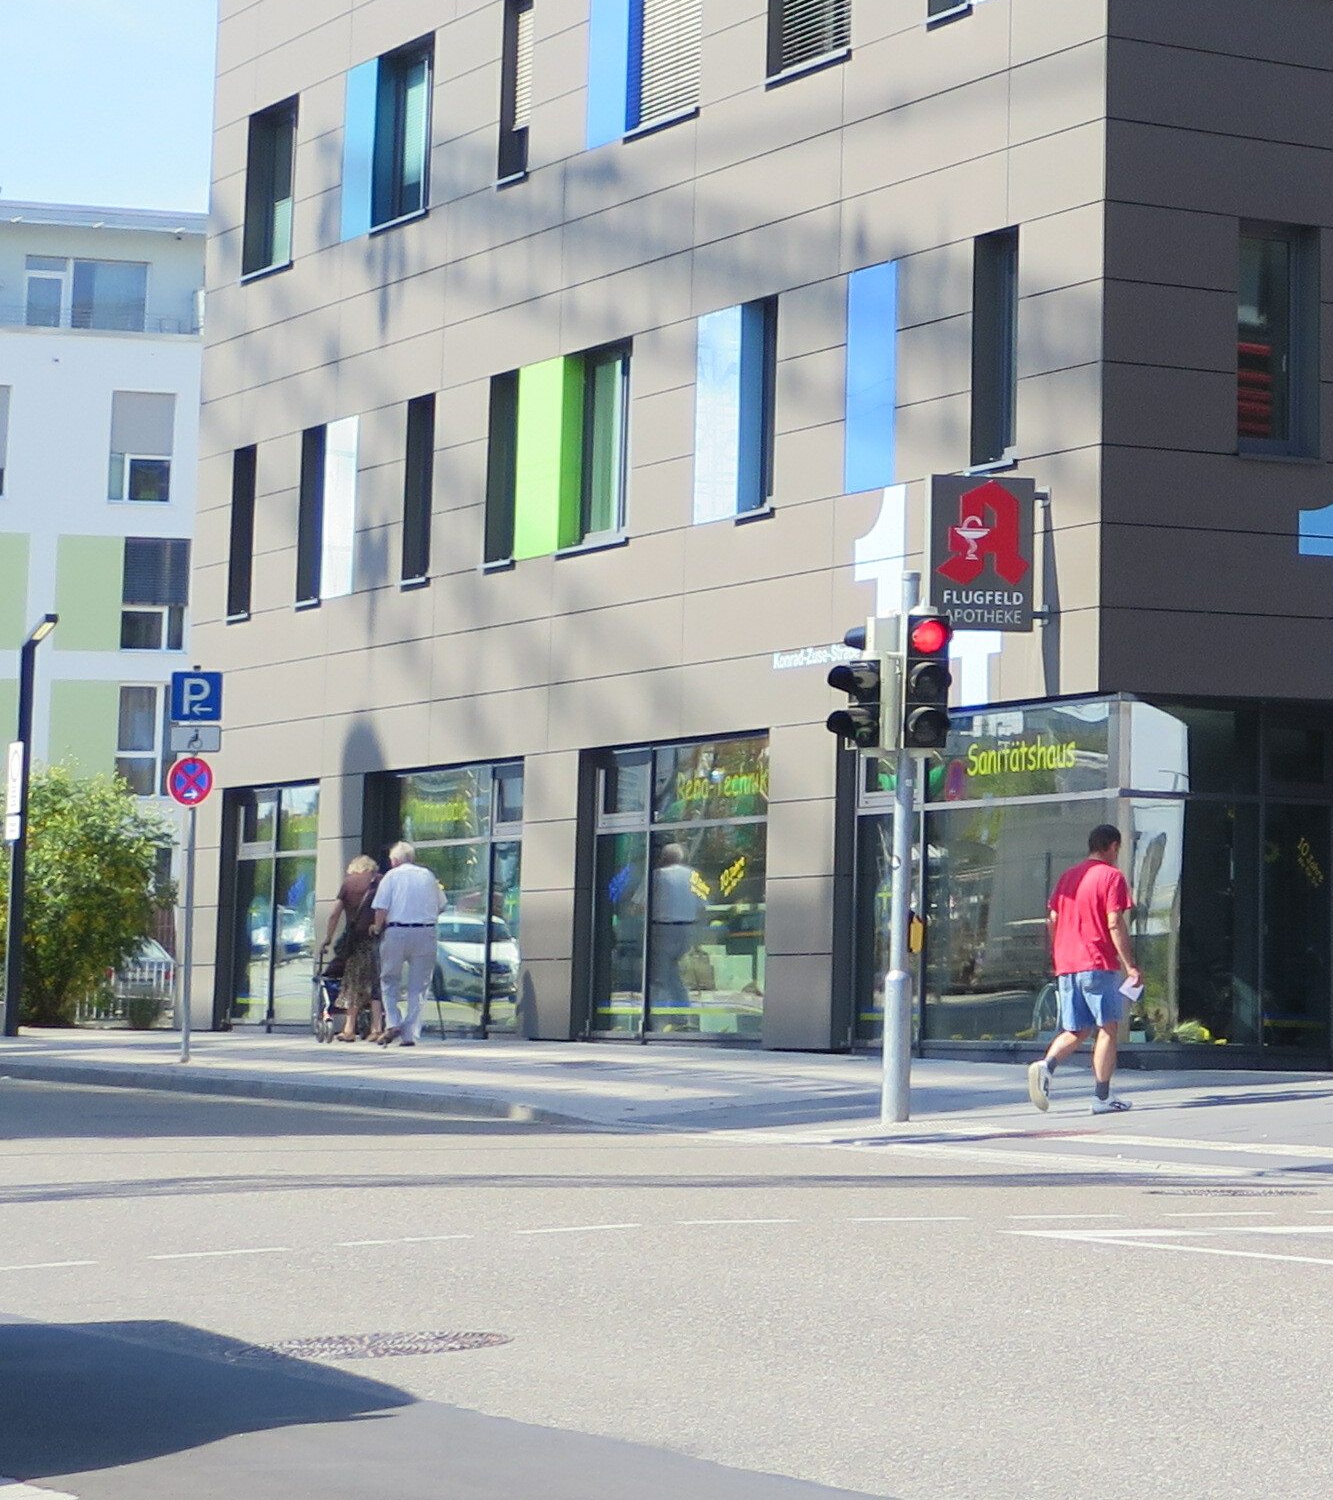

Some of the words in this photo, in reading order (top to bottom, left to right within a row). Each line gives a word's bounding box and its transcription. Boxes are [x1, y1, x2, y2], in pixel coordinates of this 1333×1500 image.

[943, 589, 1023, 606] FLUGFELD
[944, 608, 1022, 624] APOTHEKE
[182, 678, 211, 715] P
[966, 735, 1077, 777] Sanitätshaus
